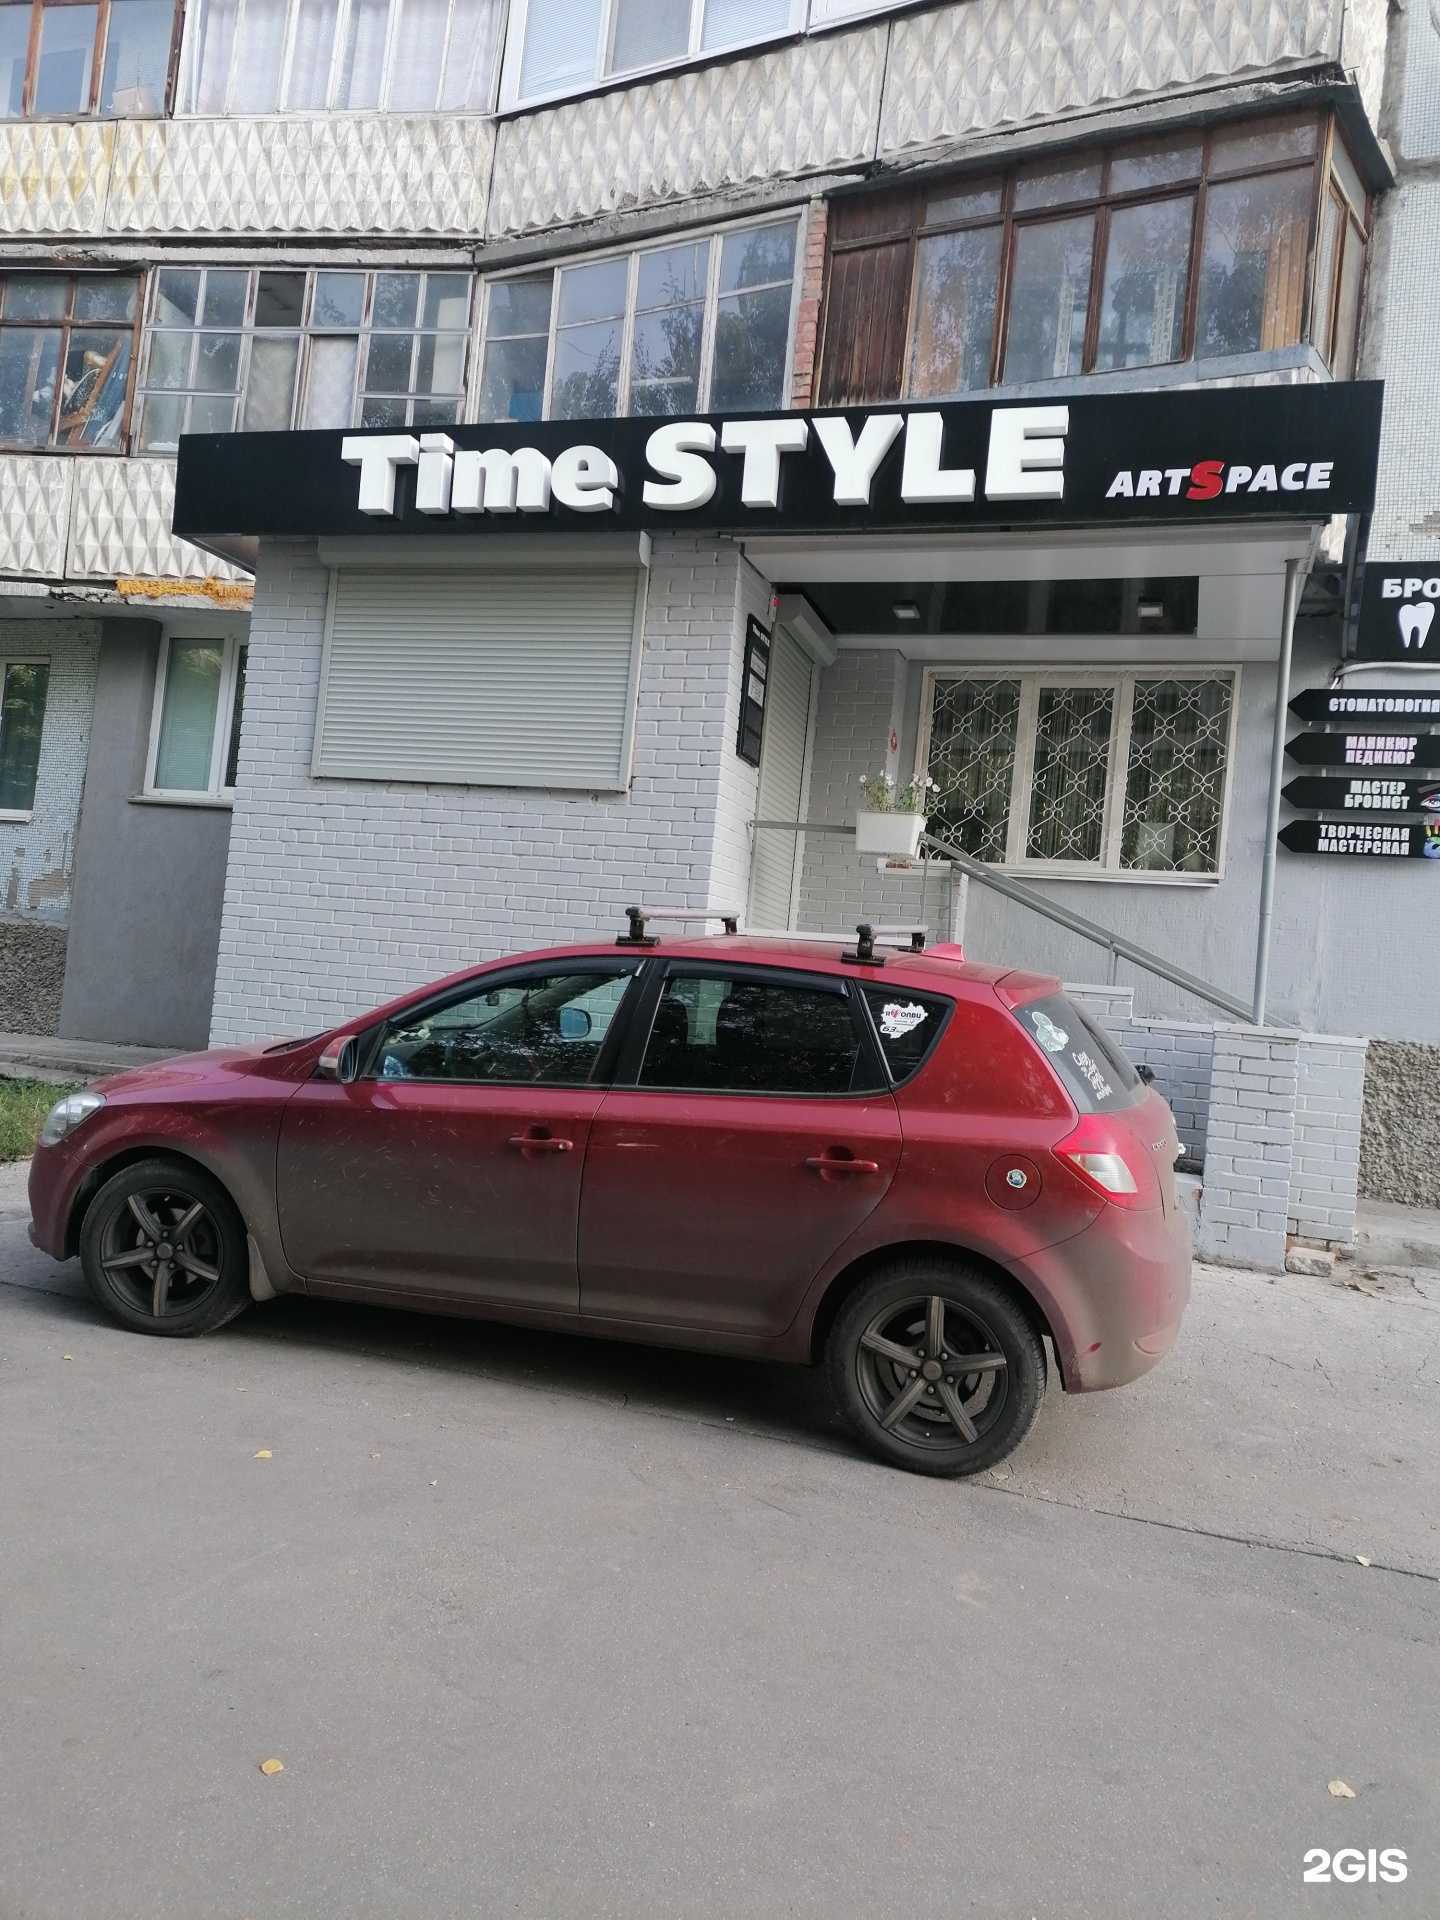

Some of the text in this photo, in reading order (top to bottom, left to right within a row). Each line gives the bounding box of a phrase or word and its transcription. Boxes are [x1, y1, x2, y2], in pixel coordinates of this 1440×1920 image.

[341, 405, 1069, 516] Time STYLE
[1105, 460, 1335, 500] ARTSPACE
[1328, 697, 1440, 713] СТОМАТОЛОГИЯ
[1345, 736, 1418, 751] МАНИКЮР
[1345, 750, 1416, 765] ПЕДИКЮР
[1350, 780, 1406, 795] МАСТЕР
[1344, 794, 1410, 809] БРОВИСТ
[1320, 824, 1411, 841] ТВОРЧЕСКАЯ
[1317, 839, 1410, 855] МАСТЕРСКАЯ
